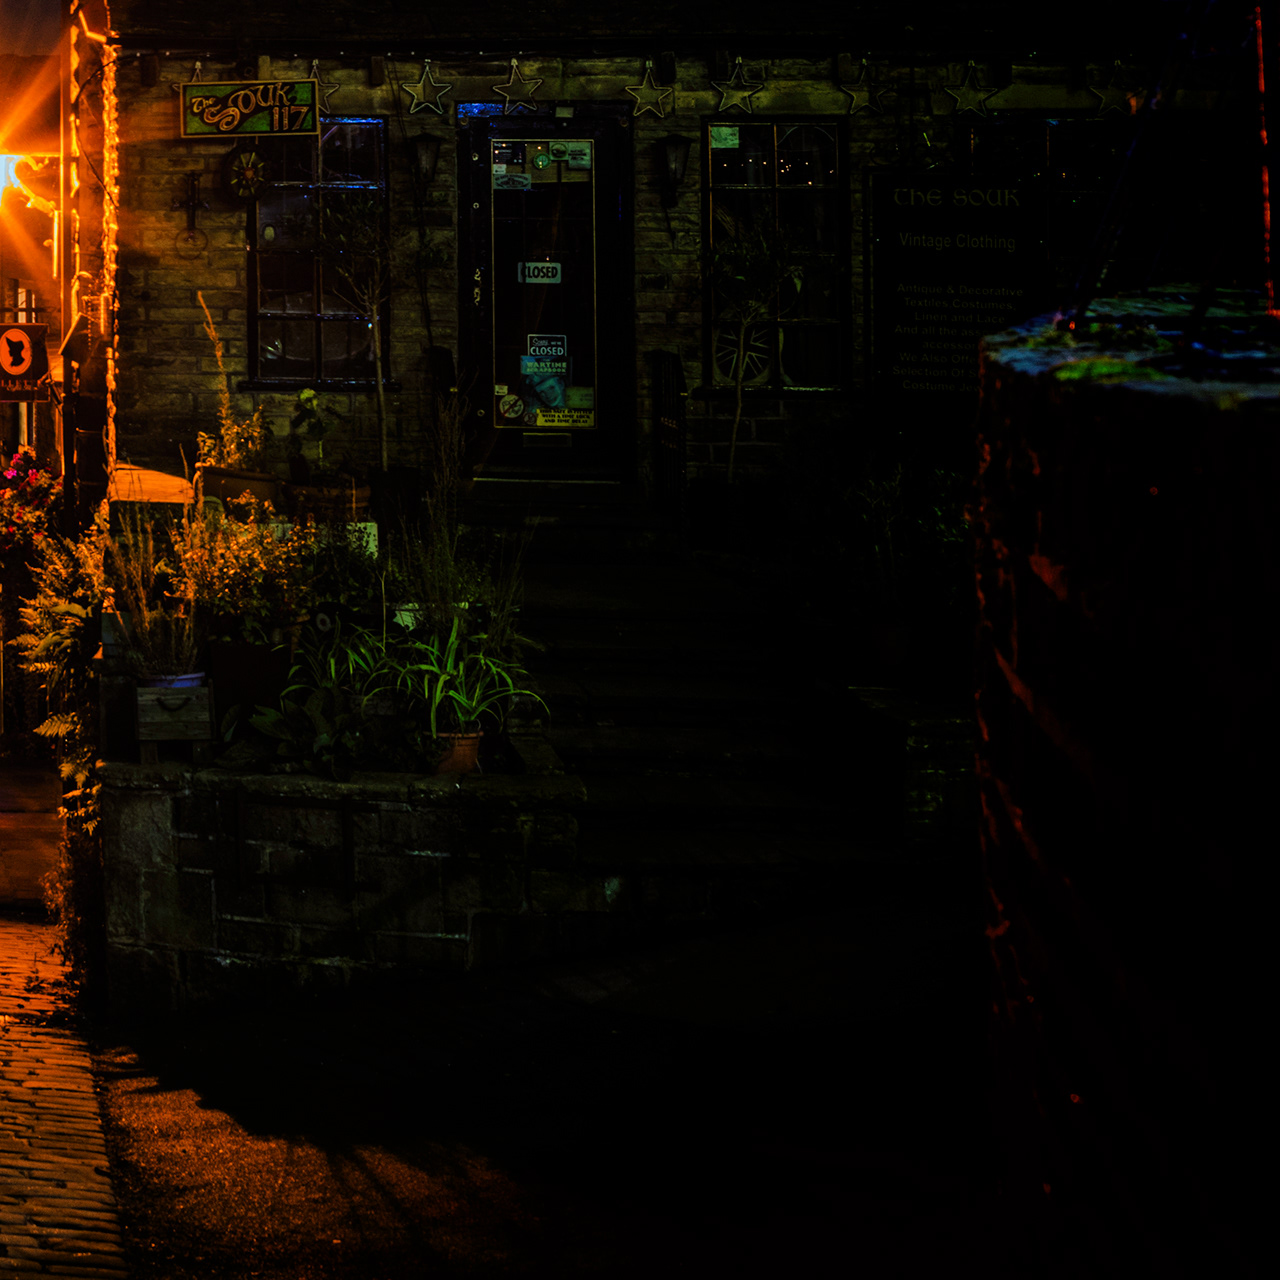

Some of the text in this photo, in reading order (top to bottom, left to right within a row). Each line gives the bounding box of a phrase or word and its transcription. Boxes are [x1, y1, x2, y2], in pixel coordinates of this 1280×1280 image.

[272, 106, 309, 131] 117
[899, 232, 1016, 253] Vintage Clothing
[521, 266, 558, 278] CLOSED
[896, 283, 1024, 297] Antique & Decorative
[914, 312, 1006, 324] Linen and Lace
[894, 324, 919, 335] And
[921, 326, 936, 336] all
[939, 327, 958, 336] the
[530, 346, 564, 356] CLOSED
[921, 341, 976, 350] accessor
[899, 351, 977, 365] We Also Offe
[892, 365, 948, 377] Selection
[902, 380, 956, 391] Costume
